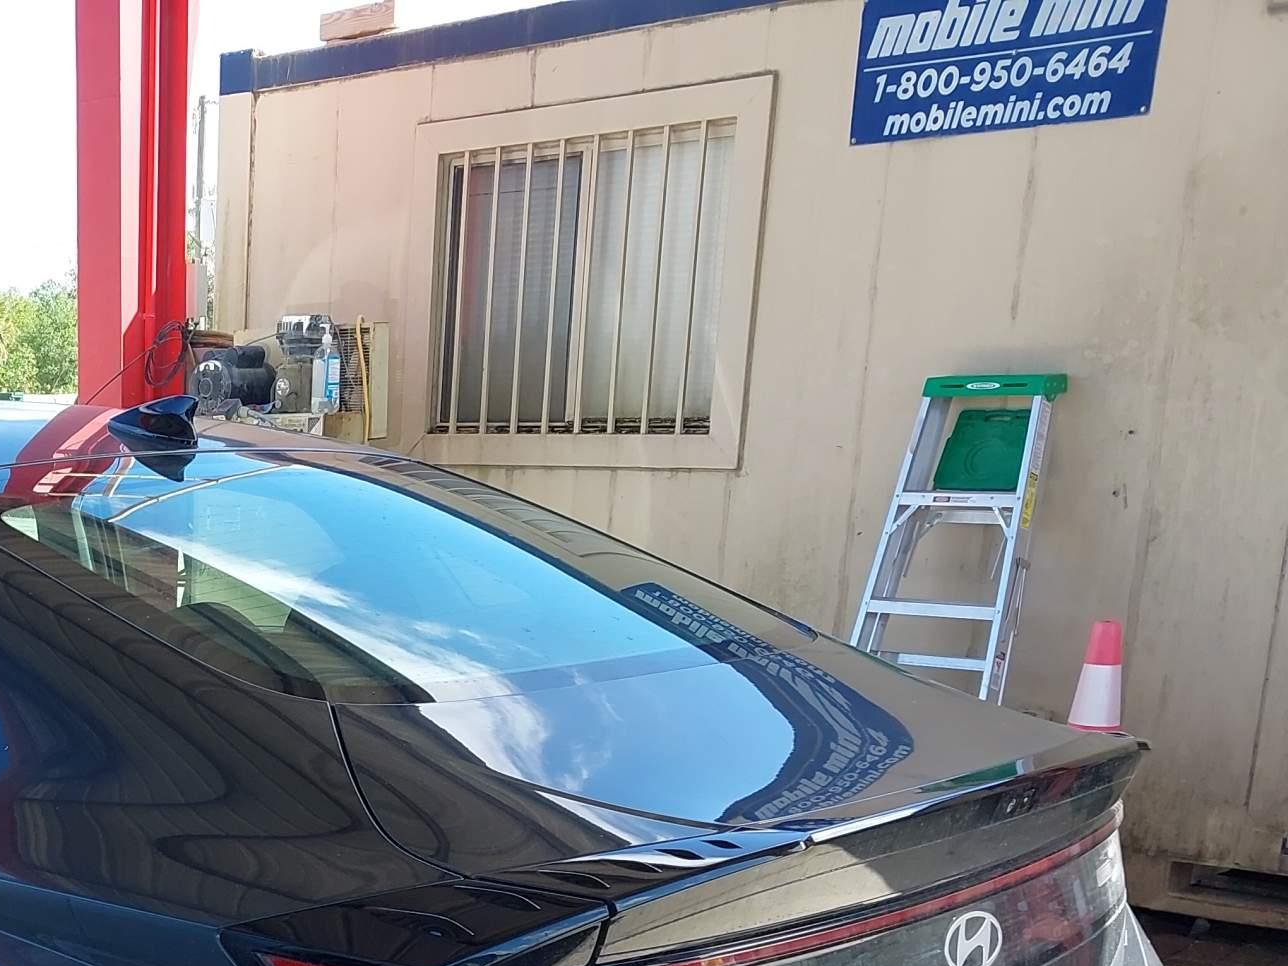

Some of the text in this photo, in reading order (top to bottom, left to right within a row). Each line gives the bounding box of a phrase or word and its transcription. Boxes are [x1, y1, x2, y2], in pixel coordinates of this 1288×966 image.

[866, 0, 1030, 60] mobile
[873, 41, 1134, 103] 1-800-950-6464
[883, 90, 1112, 136] mobilemini.com
